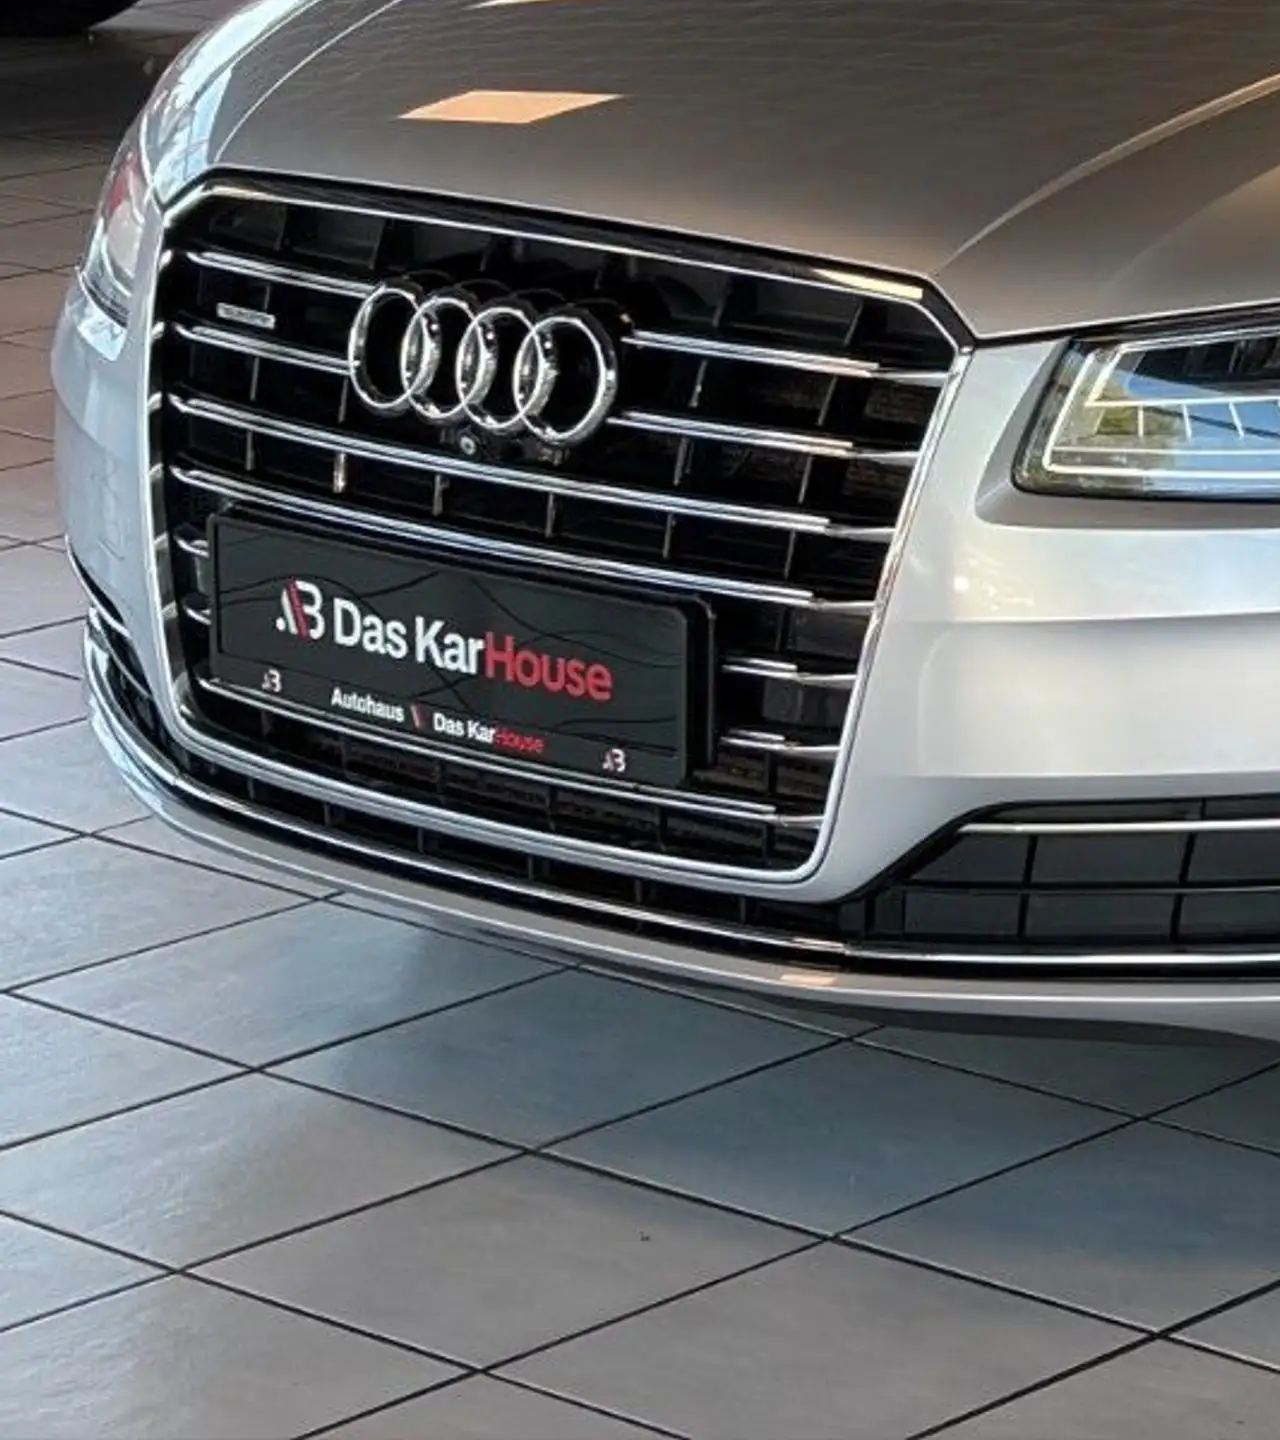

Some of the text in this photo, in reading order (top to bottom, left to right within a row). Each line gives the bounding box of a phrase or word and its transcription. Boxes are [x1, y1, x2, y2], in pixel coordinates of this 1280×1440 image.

[333, 597, 407, 659] Das
[331, 686, 404, 723] Autohaus
[433, 711, 464, 736] Das
